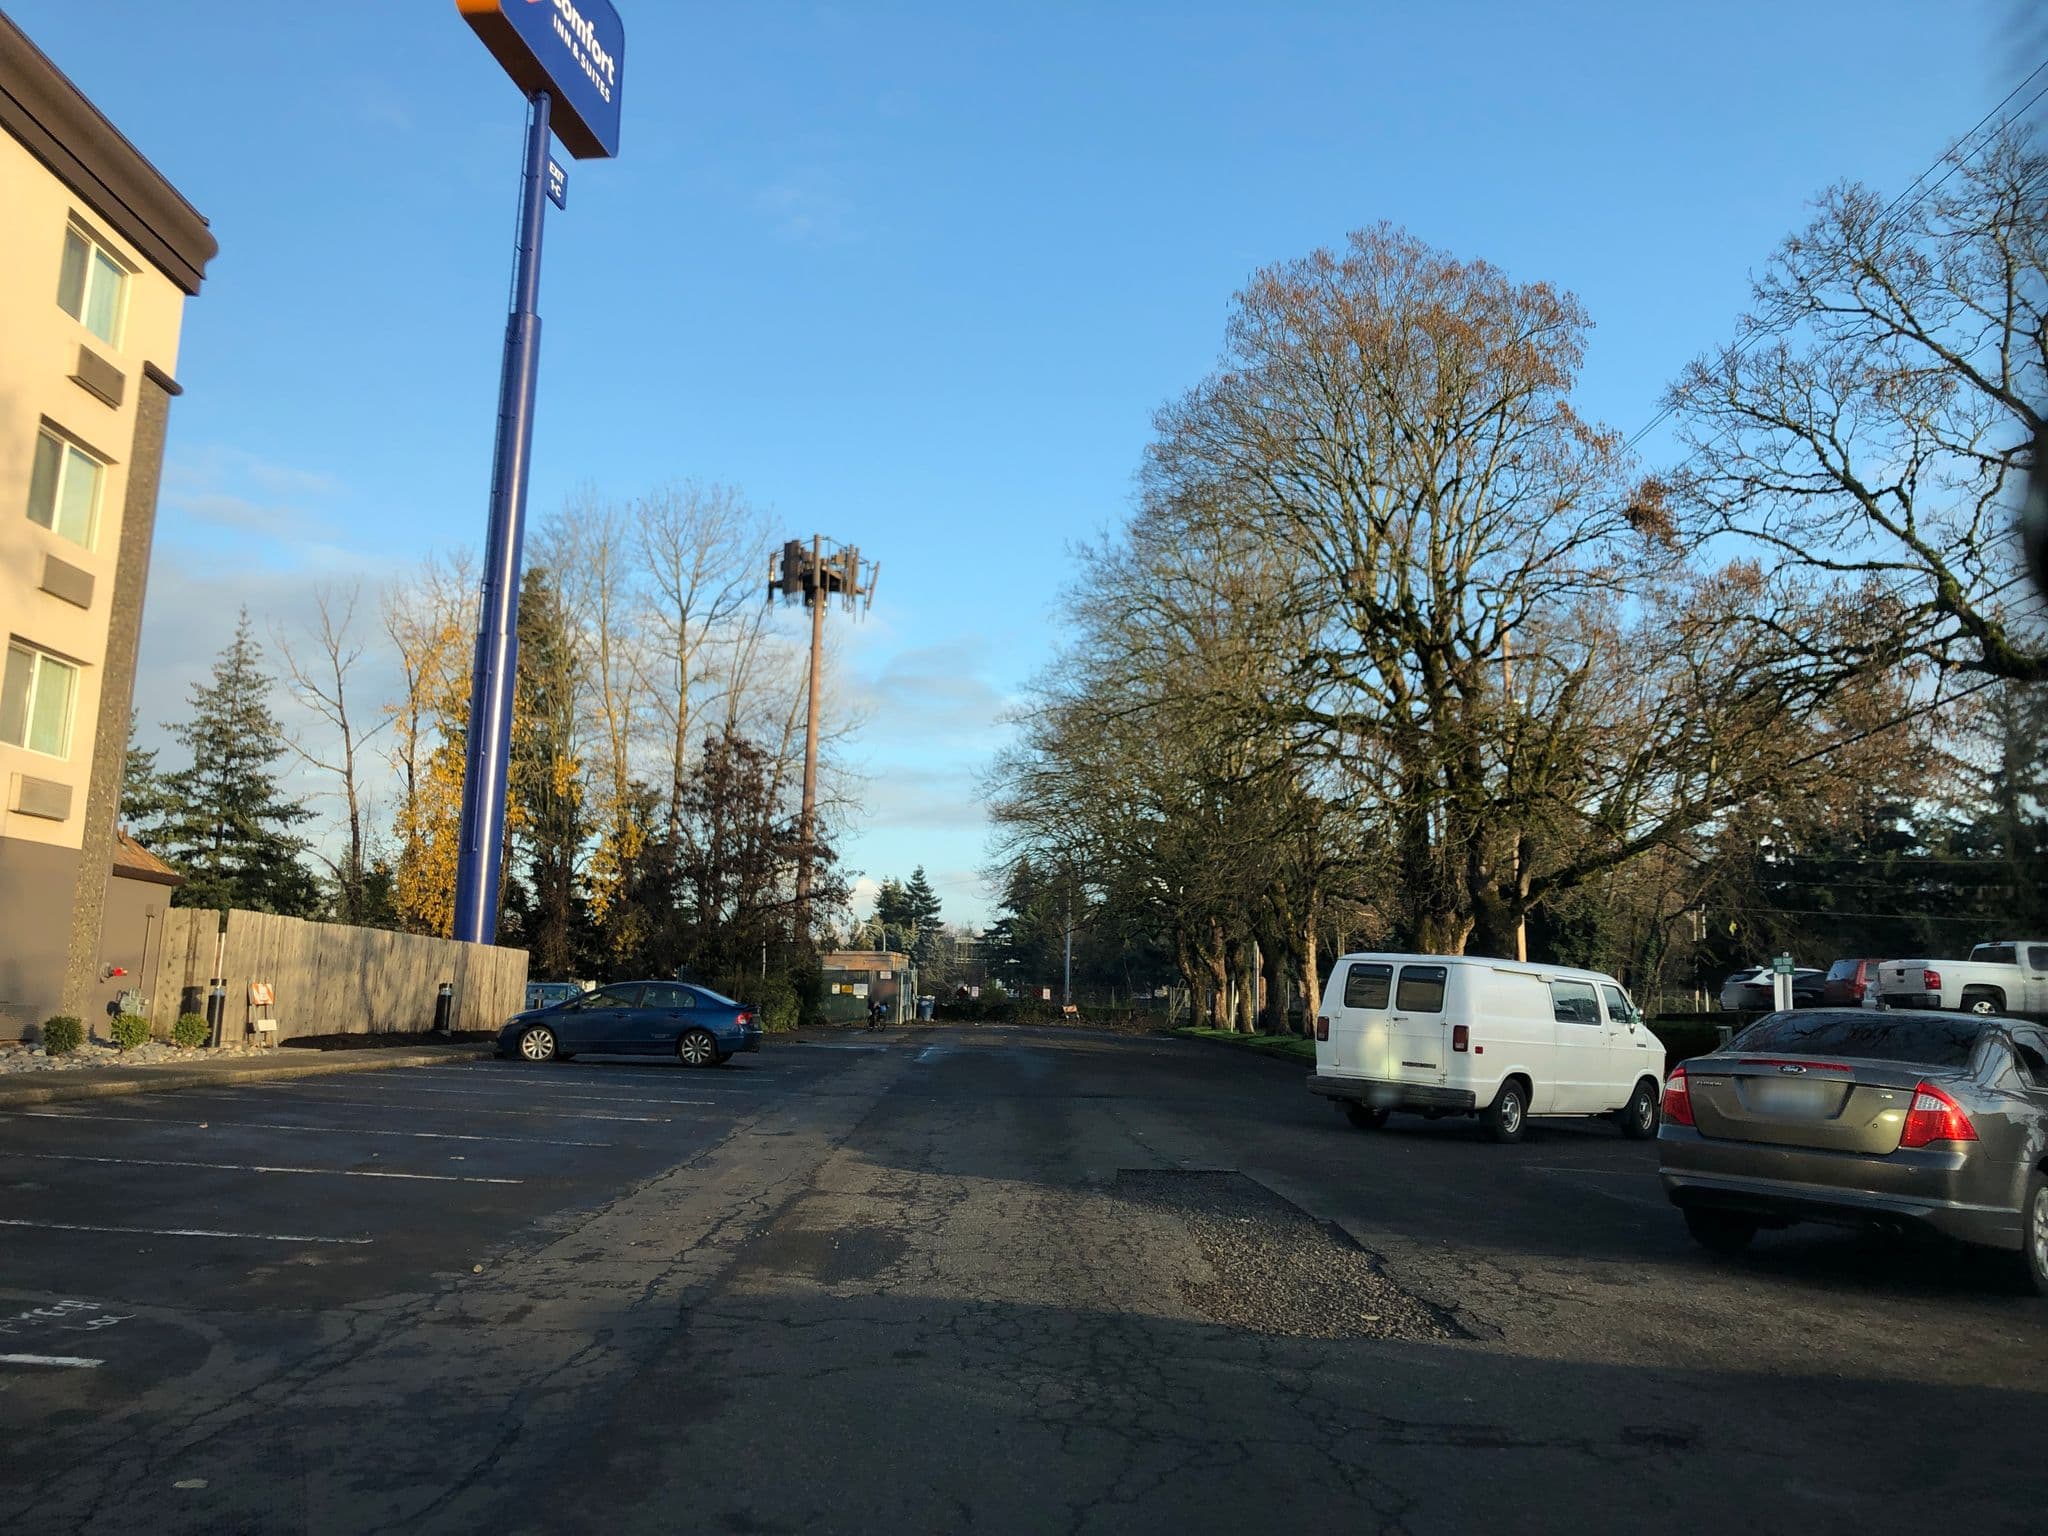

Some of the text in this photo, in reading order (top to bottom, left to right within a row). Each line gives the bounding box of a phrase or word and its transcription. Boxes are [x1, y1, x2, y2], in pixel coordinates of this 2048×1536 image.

[553, 13, 610, 103] INN & SUITES
[549, 160, 564, 184] EXIT
